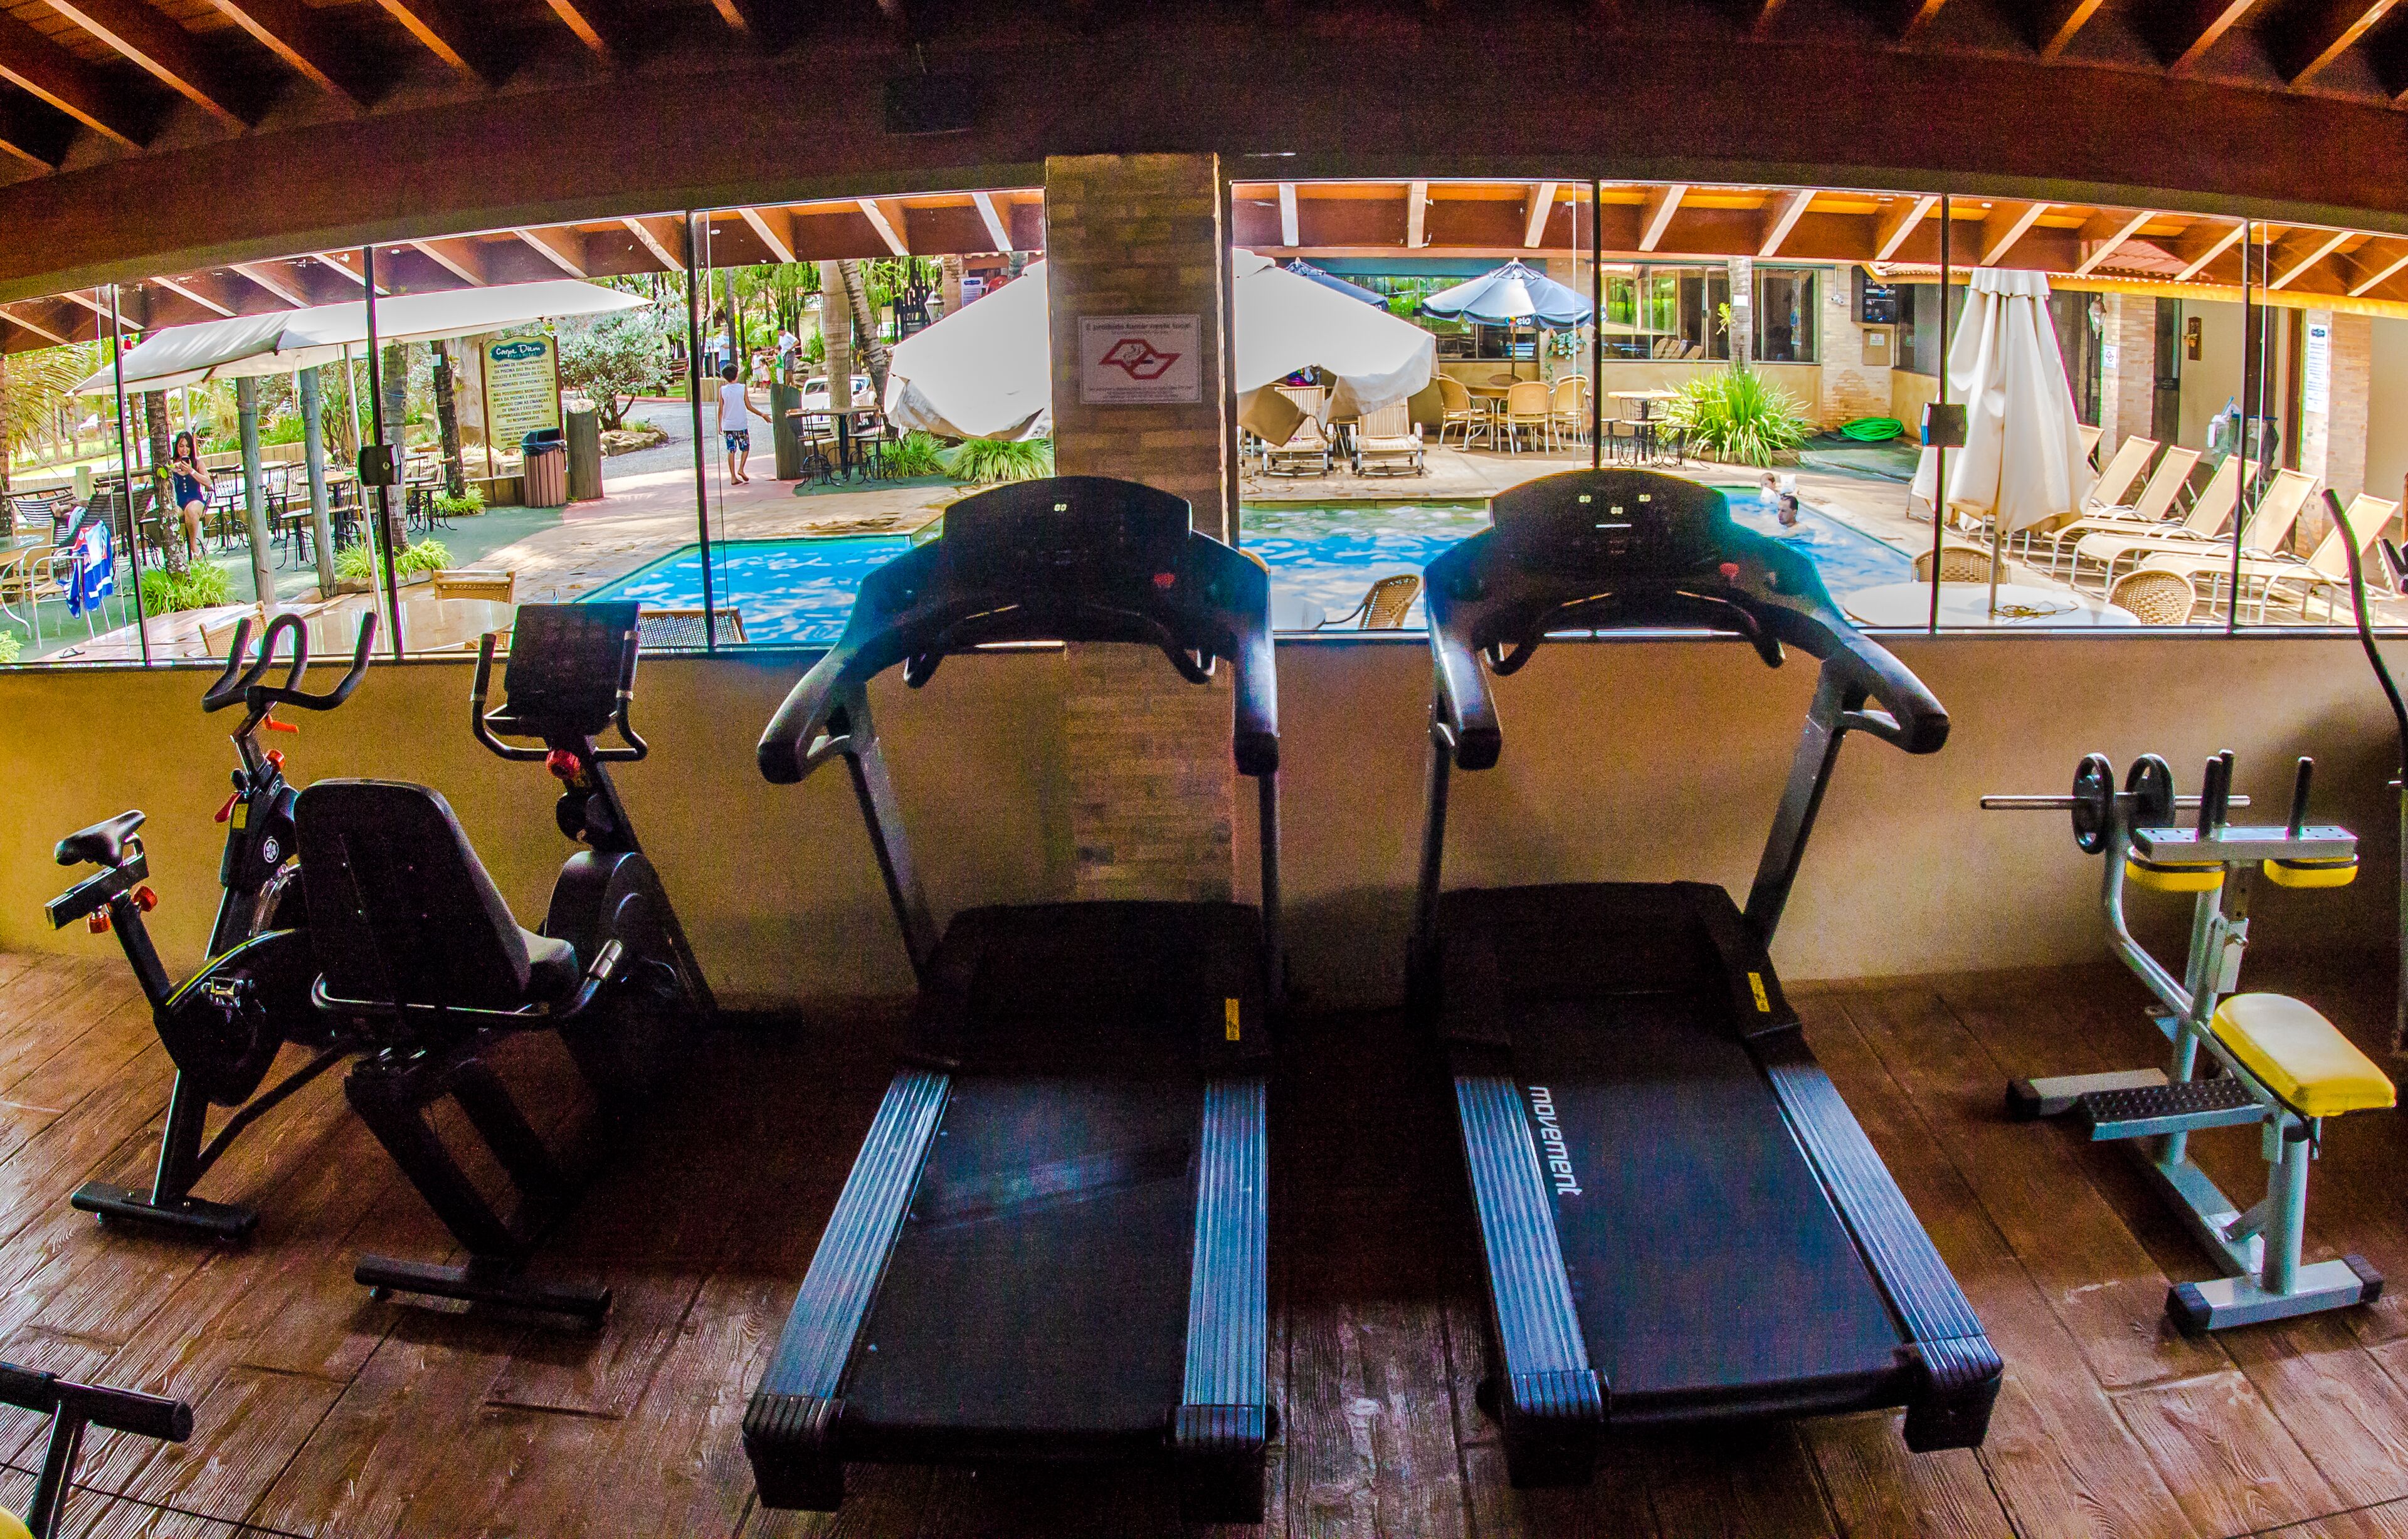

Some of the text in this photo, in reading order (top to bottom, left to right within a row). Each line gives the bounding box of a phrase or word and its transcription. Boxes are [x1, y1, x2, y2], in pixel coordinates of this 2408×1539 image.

[1516, 317, 1531, 325] elo
[496, 345, 540, 357] Carpe Diem
[1528, 1086, 1583, 1195] movement
